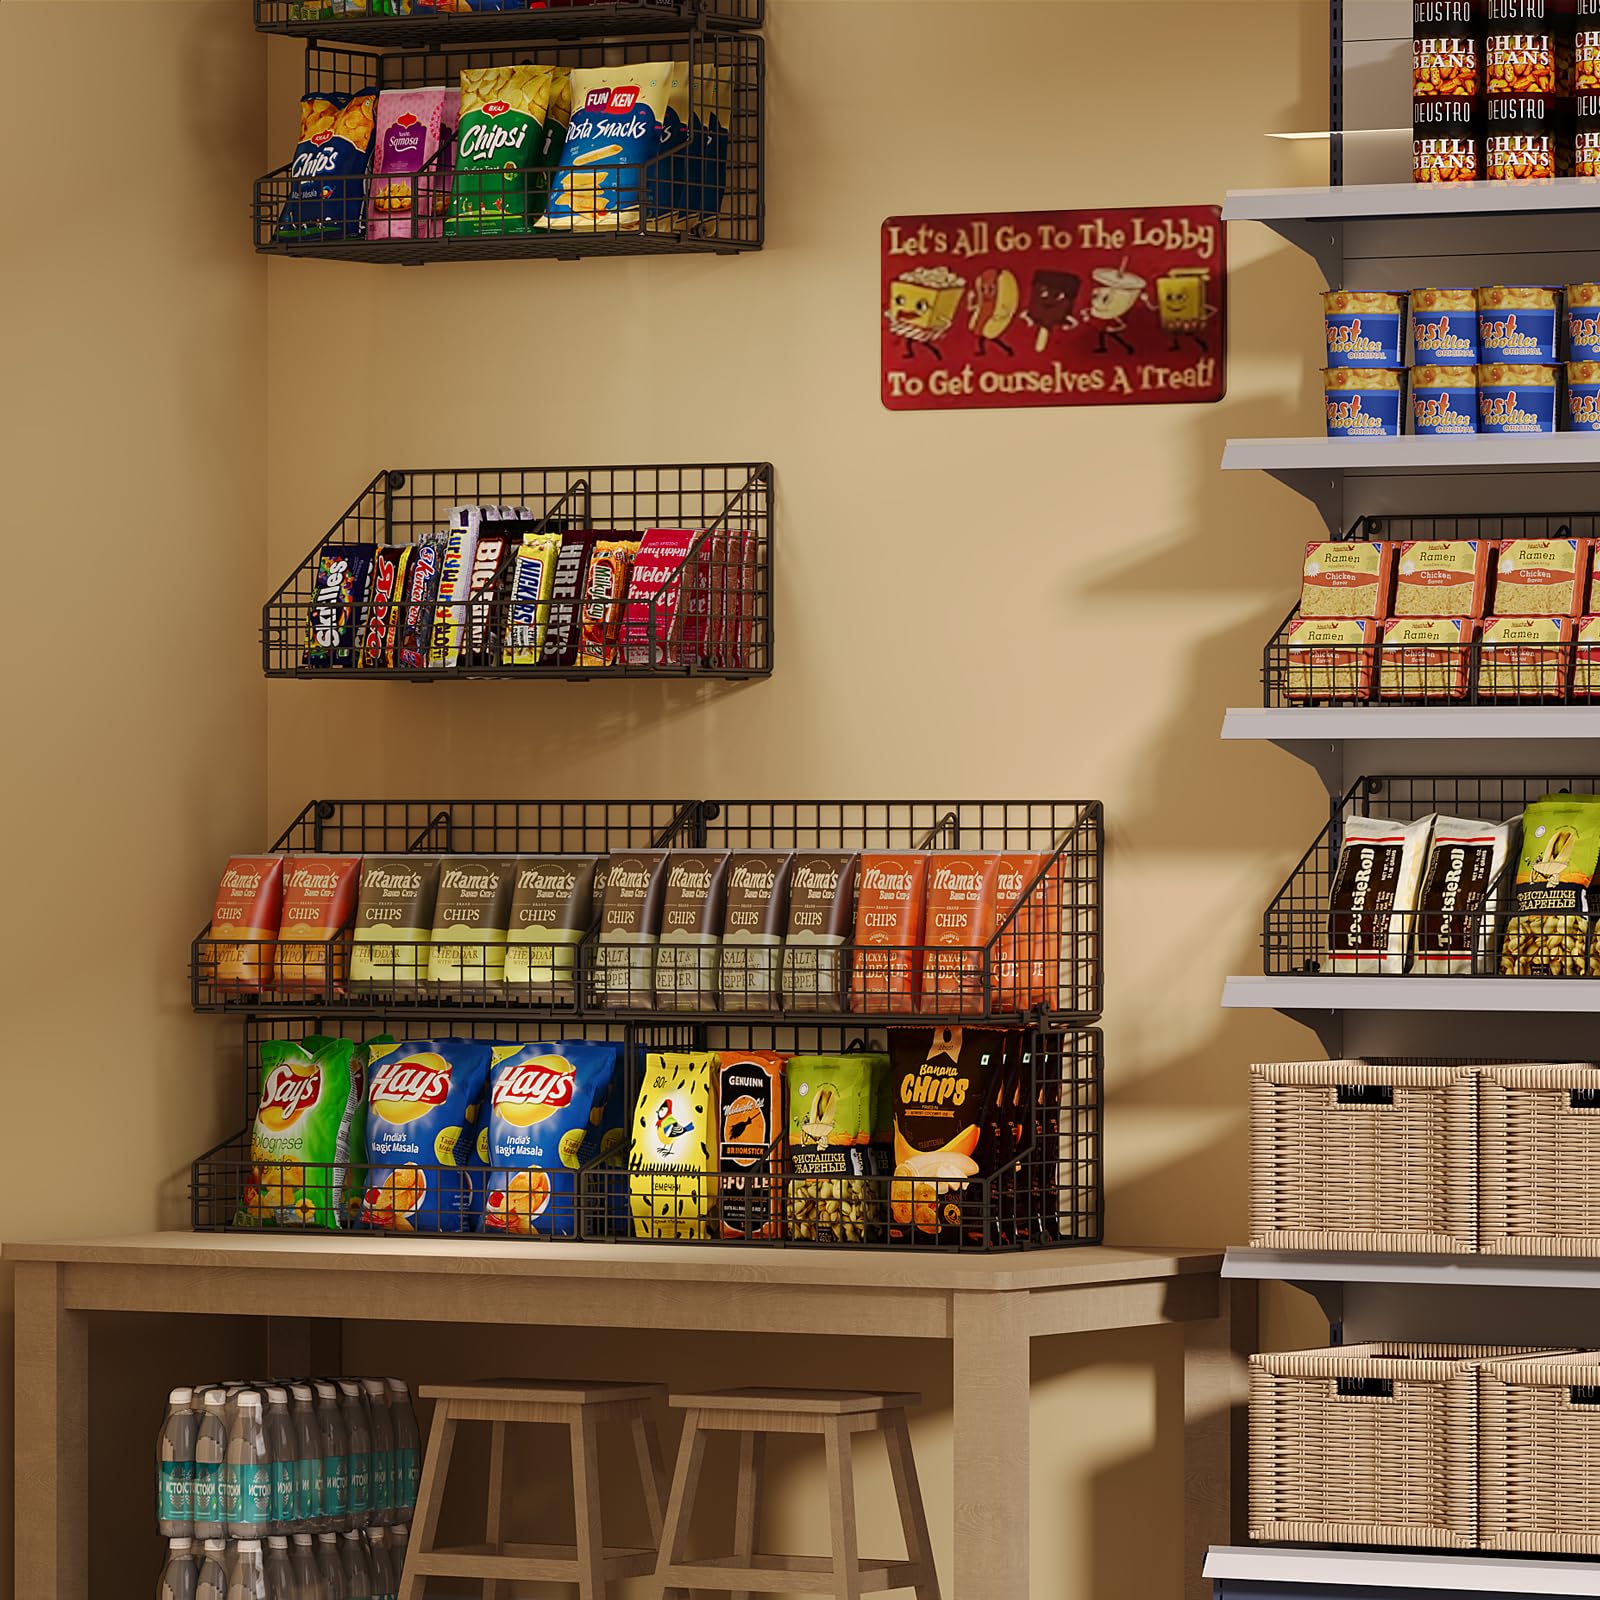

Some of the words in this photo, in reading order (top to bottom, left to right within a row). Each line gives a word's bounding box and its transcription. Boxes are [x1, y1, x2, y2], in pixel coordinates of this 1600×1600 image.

[1415, 1, 1470, 22] DEUSTRO
[1488, 0, 1544, 18] DEUSTRO
[1413, 38, 1475, 55] CHILI
[1486, 35, 1549, 51] CHILI
[1413, 55, 1475, 69] BEANS
[1487, 51, 1549, 66] BEANS
[587, 92, 608, 106] FUN
[611, 92, 635, 107] KEN
[1415, 101, 1470, 123] DEUSTRO
[1488, 99, 1544, 120] DEUSTRO
[592, 115, 647, 139] Snacks
[388, 134, 419, 149] Samosa
[461, 124, 528, 160] Chipsi
[1413, 139, 1475, 155] CHILI
[1486, 136, 1549, 152] CHILI
[292, 149, 338, 178] Chips
[1413, 155, 1475, 170] BEANS
[1487, 152, 1549, 166] BEANS
[888, 225, 948, 256] Let's
[952, 222, 989, 257] All
[996, 225, 1031, 252] Go
[1038, 225, 1072, 249] To
[1079, 219, 1125, 249] The
[1132, 218, 1215, 258] Lobby
[1330, 338, 1382, 352] noodles
[1418, 335, 1470, 350] noodles
[1485, 333, 1537, 348] noodles
[887, 371, 923, 397] To
[929, 364, 974, 395] Get
[1110, 367, 1133, 394] A
[1137, 359, 1215, 388] Treat!
[1330, 414, 1382, 428] noodles
[1418, 411, 1470, 426] noodles
[1485, 409, 1537, 424] noodles
[1502, 424, 1543, 432] ORIGINAL
[1324, 553, 1361, 563] Ramen
[1419, 552, 1456, 562] Ramen
[1518, 551, 1556, 561] Ramen
[1325, 572, 1356, 581] Chicken
[1420, 571, 1452, 580] Chicken
[1519, 570, 1551, 579] Chicken
[1308, 631, 1344, 641] Ramen
[1403, 630, 1440, 640] Ramen
[1502, 629, 1539, 639] Ramen
[220, 870, 261, 888] Mama's
[289, 868, 339, 888] Mama's
[364, 870, 421, 889] Mama's
[442, 870, 499, 889] Mama's
[517, 870, 575, 890] Mama's
[608, 866, 650, 888] Mama's
[669, 866, 712, 888] Mama's
[731, 866, 775, 889] Mama's
[795, 866, 838, 889] Mama's
[863, 868, 912, 891] Mama's
[933, 868, 983, 891] Mama's
[1518, 890, 1576, 901] ФИСТАШКИ
[1518, 899, 1576, 911] ЖАРЕНЫЕ
[217, 908, 242, 920] CHIPS
[288, 908, 319, 920] CHIPS
[365, 909, 402, 920] CHIPS
[443, 909, 480, 921] CHIPS
[519, 910, 556, 921] CHIPS
[607, 911, 635, 924] CHIPS
[668, 911, 695, 925] CHIPS
[730, 912, 758, 925] CHIPS
[794, 912, 822, 925] CHIPS
[864, 913, 897, 927] CHIPS
[935, 913, 967, 927] CHIPS
[919, 1063, 958, 1077] Banana
[369, 1065, 451, 1104] Hay's
[492, 1066, 574, 1106] Hay's
[728, 1075, 764, 1088] GENUINN
[259, 1065, 319, 1121] Say's
[900, 1073, 969, 1106] CHIPS
[251, 1132, 303, 1153] Bolognese
[383, 1132, 407, 1143] India's
[506, 1135, 531, 1145] India's
[393, 1143, 419, 1155] Masala
[516, 1146, 543, 1157] Masala
[792, 1153, 846, 1163] ФИСТАШКИ
[795, 1162, 847, 1173] ЖАРЕНЫЕ
